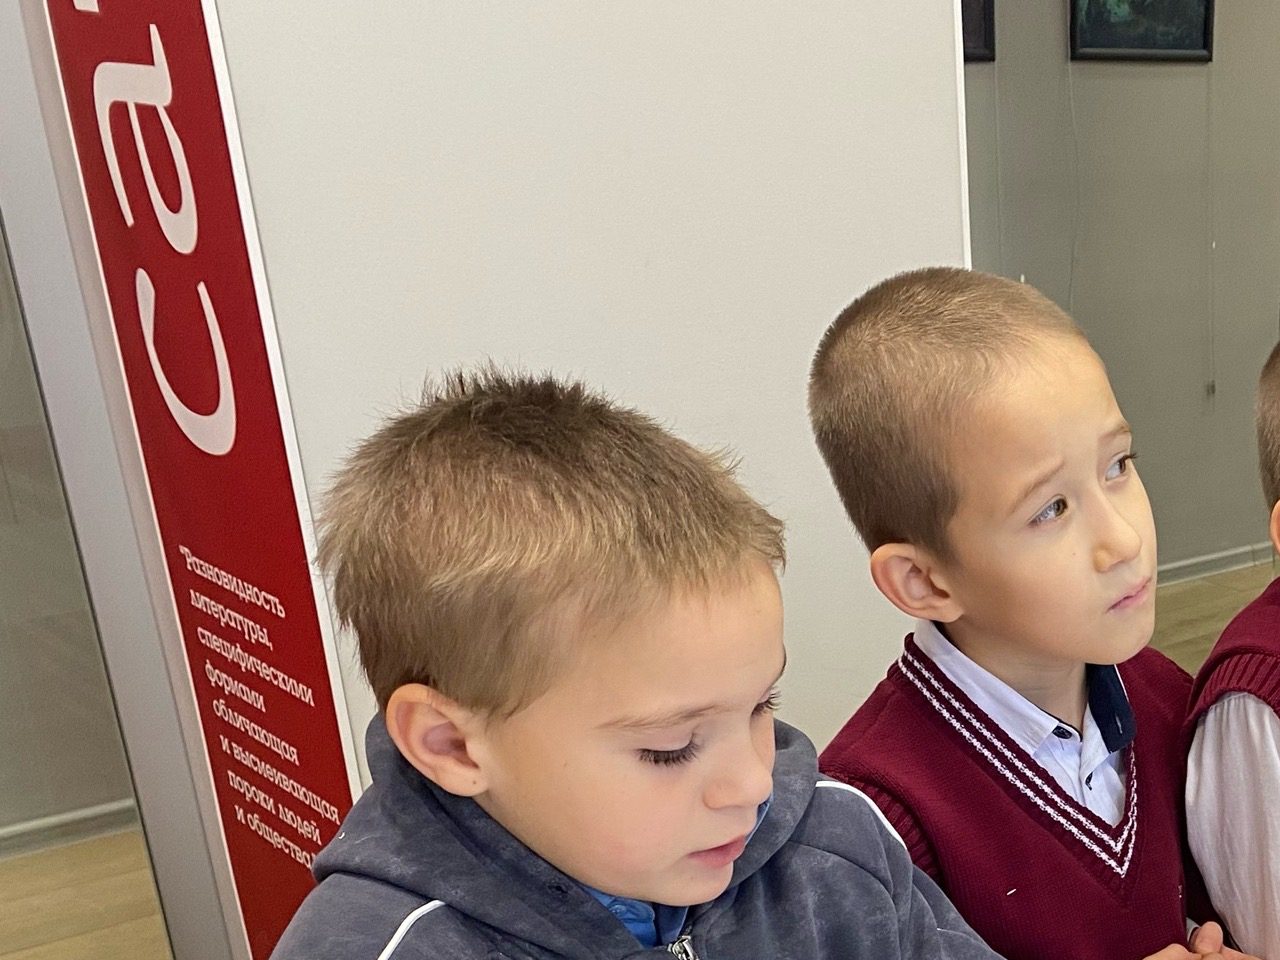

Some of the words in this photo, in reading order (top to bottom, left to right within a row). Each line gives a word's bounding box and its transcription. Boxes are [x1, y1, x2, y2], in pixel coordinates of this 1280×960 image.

[73, 0, 237, 456] са
[189, 589, 273, 651] литературы,
[197, 627, 315, 707] специфическими
[204, 659, 267, 713] формами
[212, 699, 300, 766] обличающая
[219, 734, 231, 755] и
[231, 741, 341, 826] высмеивающая
[226, 770, 276, 815] пороки
[277, 803, 322, 846] людей
[234, 805, 246, 825] и
